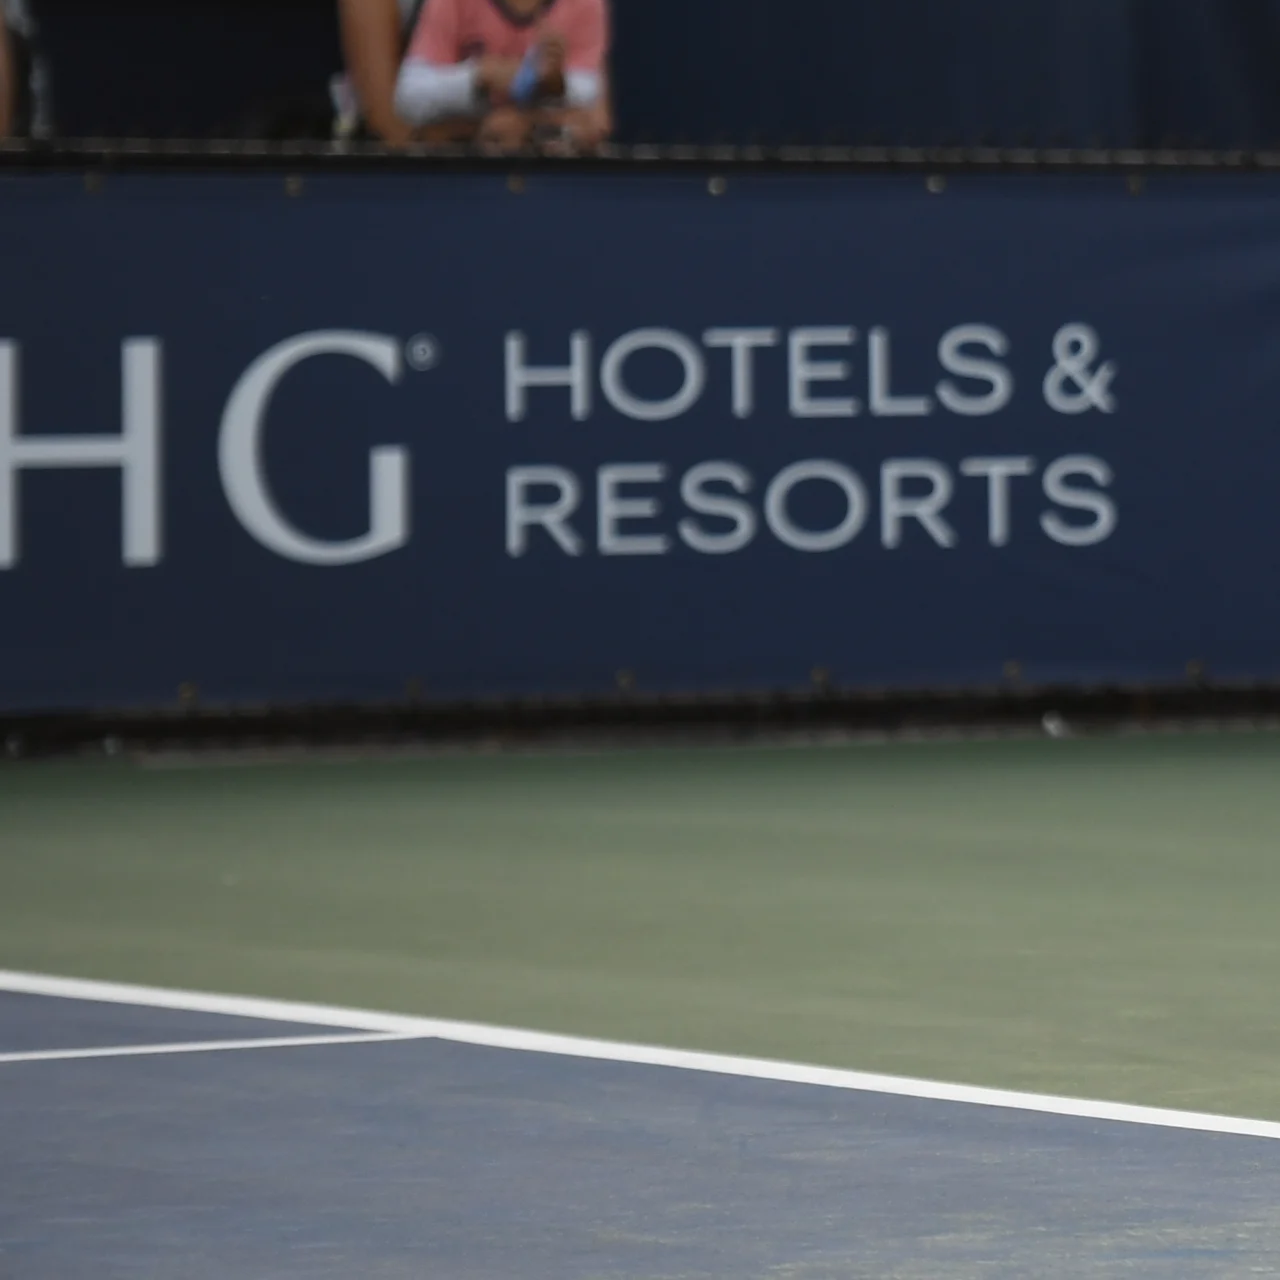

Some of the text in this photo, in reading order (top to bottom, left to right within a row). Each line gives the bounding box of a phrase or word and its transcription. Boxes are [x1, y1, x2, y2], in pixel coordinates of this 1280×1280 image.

[504, 322, 1116, 422] HOTELS &
[505, 454, 1118, 557] RESORTS
